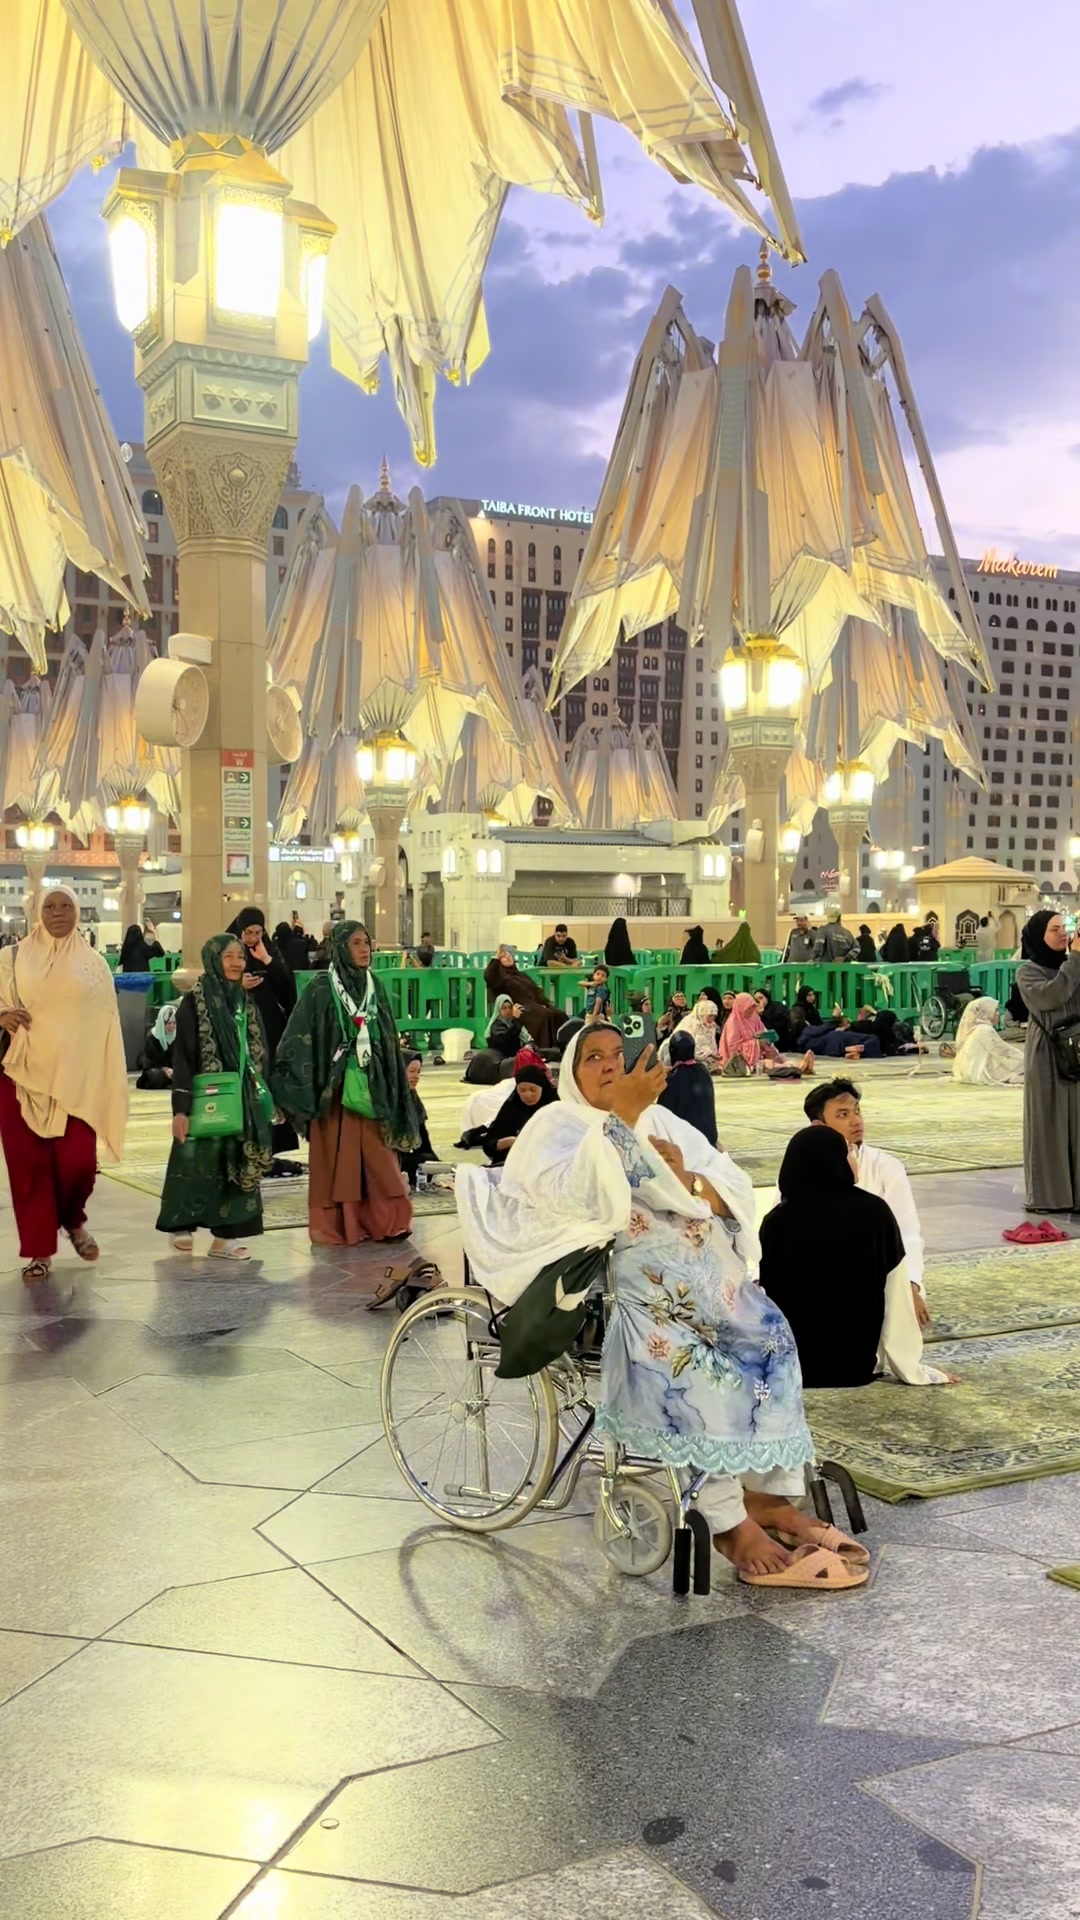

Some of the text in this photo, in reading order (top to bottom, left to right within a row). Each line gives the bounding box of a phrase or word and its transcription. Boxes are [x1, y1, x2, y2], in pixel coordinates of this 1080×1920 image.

[481, 499, 516, 515] TAIBA
[518, 504, 557, 519] FRONT
[977, 547, 1058, 578] Makarem
